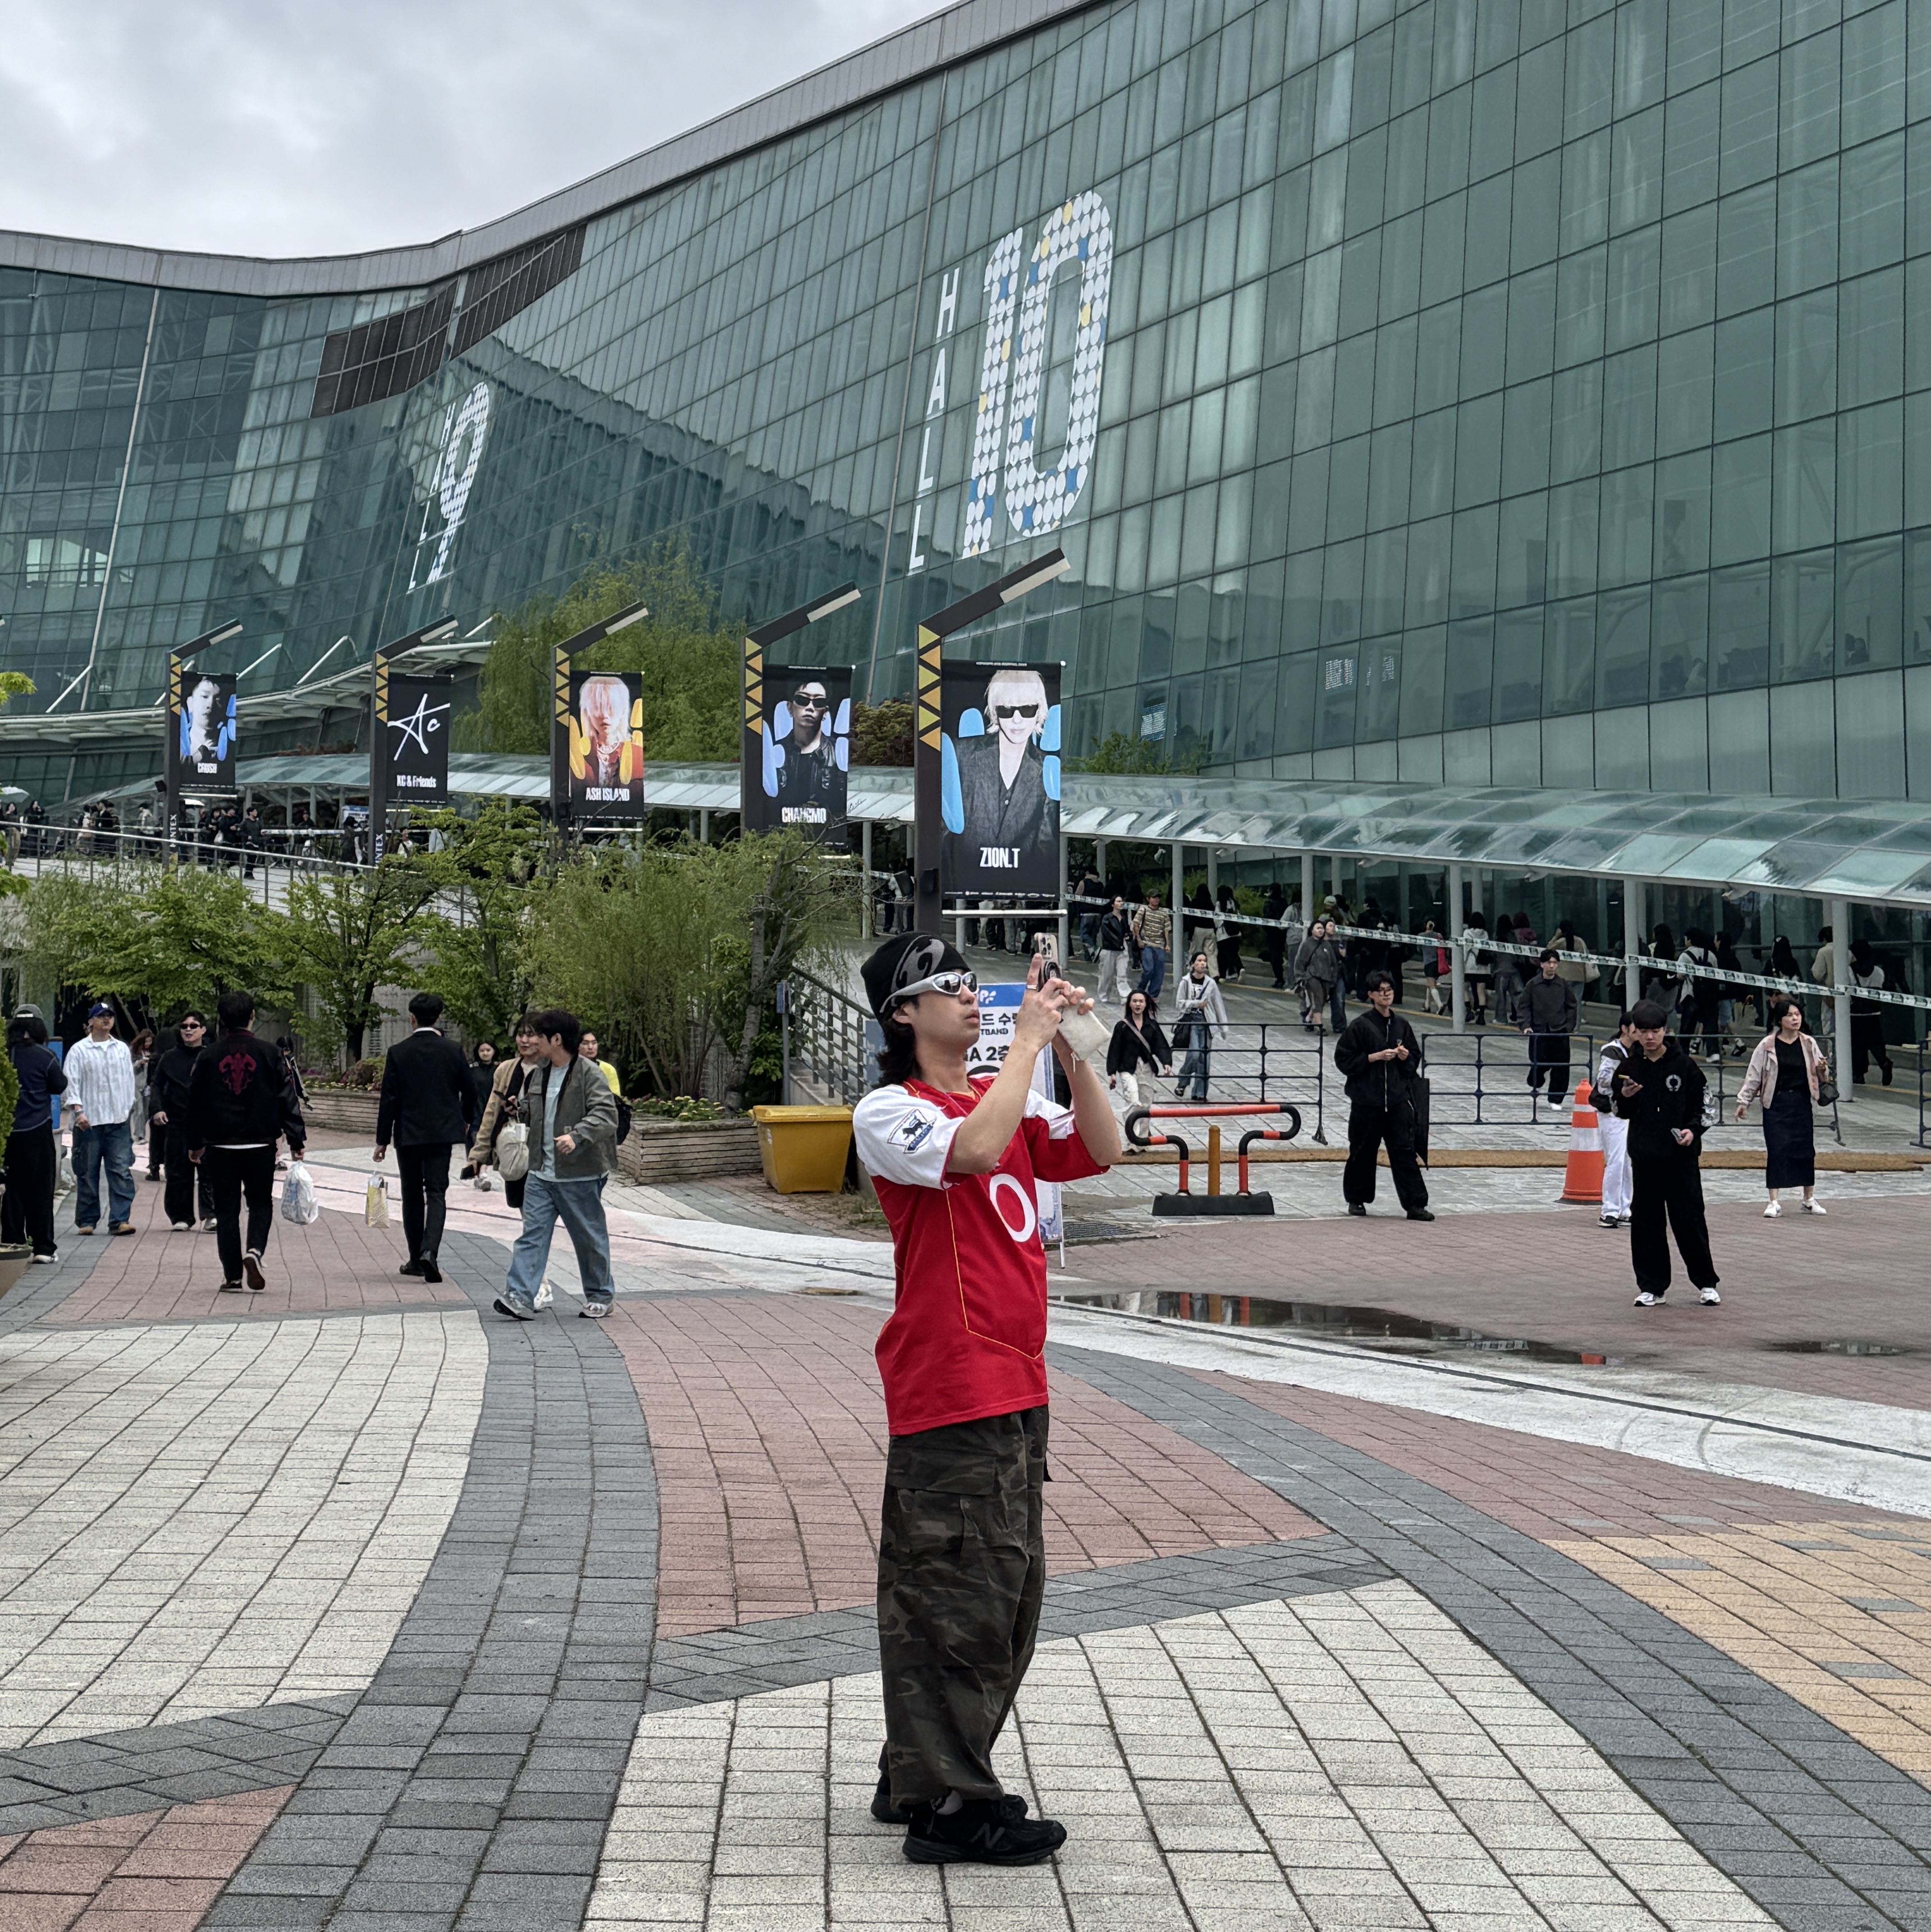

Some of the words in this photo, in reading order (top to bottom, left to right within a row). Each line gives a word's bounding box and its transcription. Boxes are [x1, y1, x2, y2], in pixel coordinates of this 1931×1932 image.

[908, 267, 959, 572] HALL
[962, 190, 1112, 559] 10
[408, 402, 456, 590] HALL
[427, 382, 489, 583] 9
[407, 775, 412, 787] &
[413, 775, 436, 788] Friends
[586, 787, 601, 801] ASH
[602, 788, 630, 801] ISLAND
[781, 807, 826, 824] CHANGMO
[980, 847, 1020, 868] ZION.T
